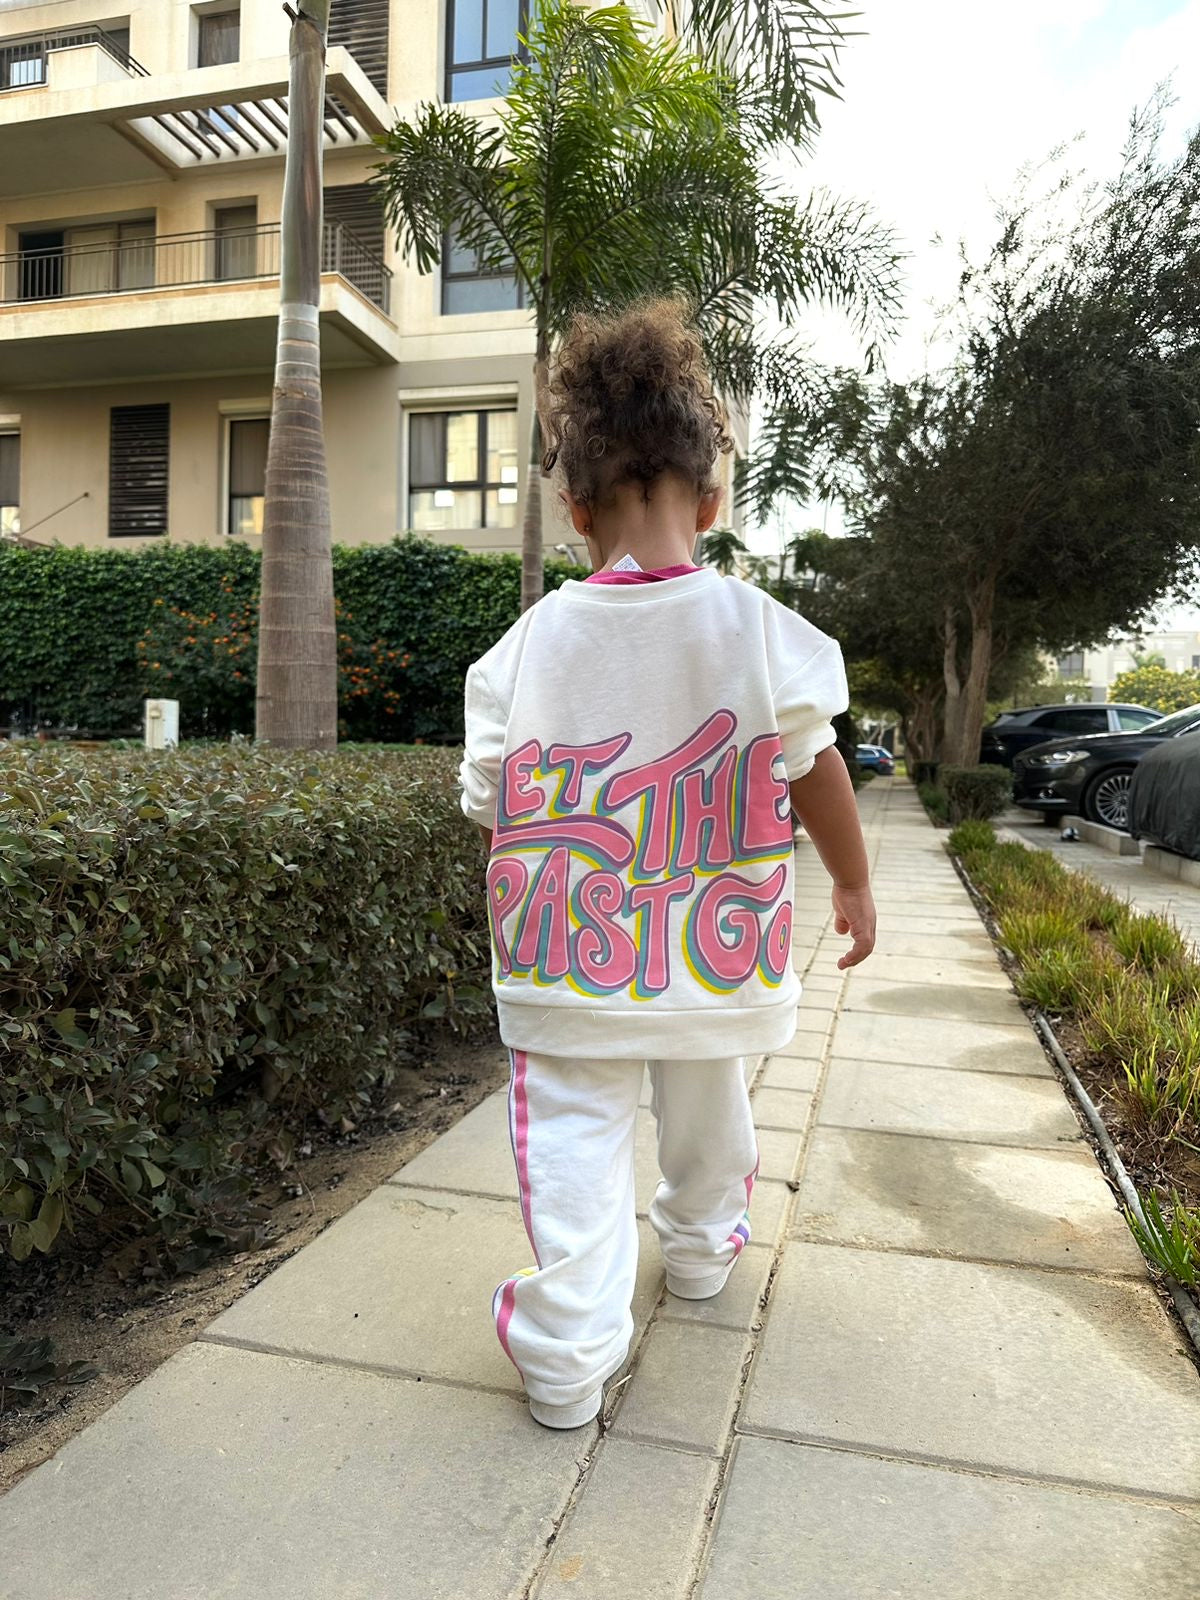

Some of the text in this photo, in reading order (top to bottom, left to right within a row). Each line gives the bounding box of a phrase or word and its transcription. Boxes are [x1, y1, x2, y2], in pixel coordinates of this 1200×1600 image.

[595, 708, 794, 882] THE
[487, 847, 793, 1000] PAST GO
